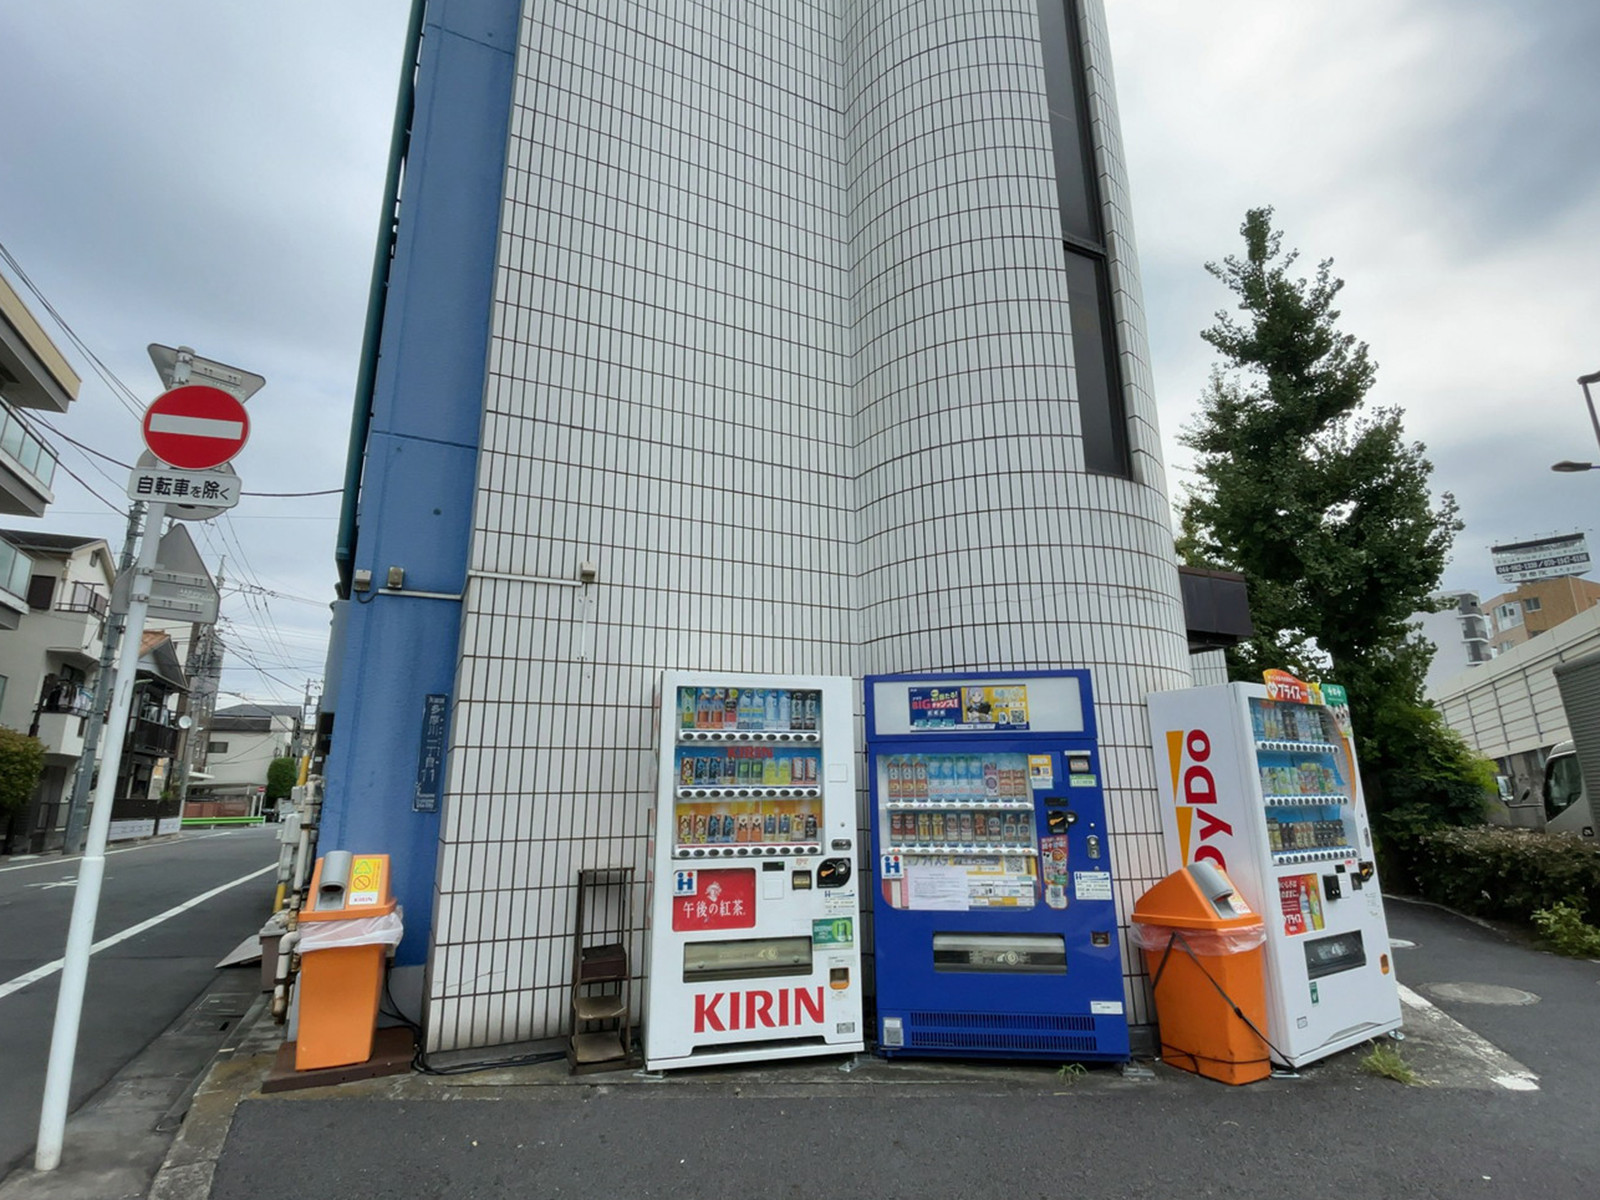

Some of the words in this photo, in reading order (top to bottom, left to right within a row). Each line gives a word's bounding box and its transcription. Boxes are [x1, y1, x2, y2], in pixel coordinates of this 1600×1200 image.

[137, 475, 230, 500] 自転車を除く
[727, 746, 773, 759] KIRIN
[683, 899, 744, 919] 午後の紅茶
[693, 986, 824, 1033] KIRIN
